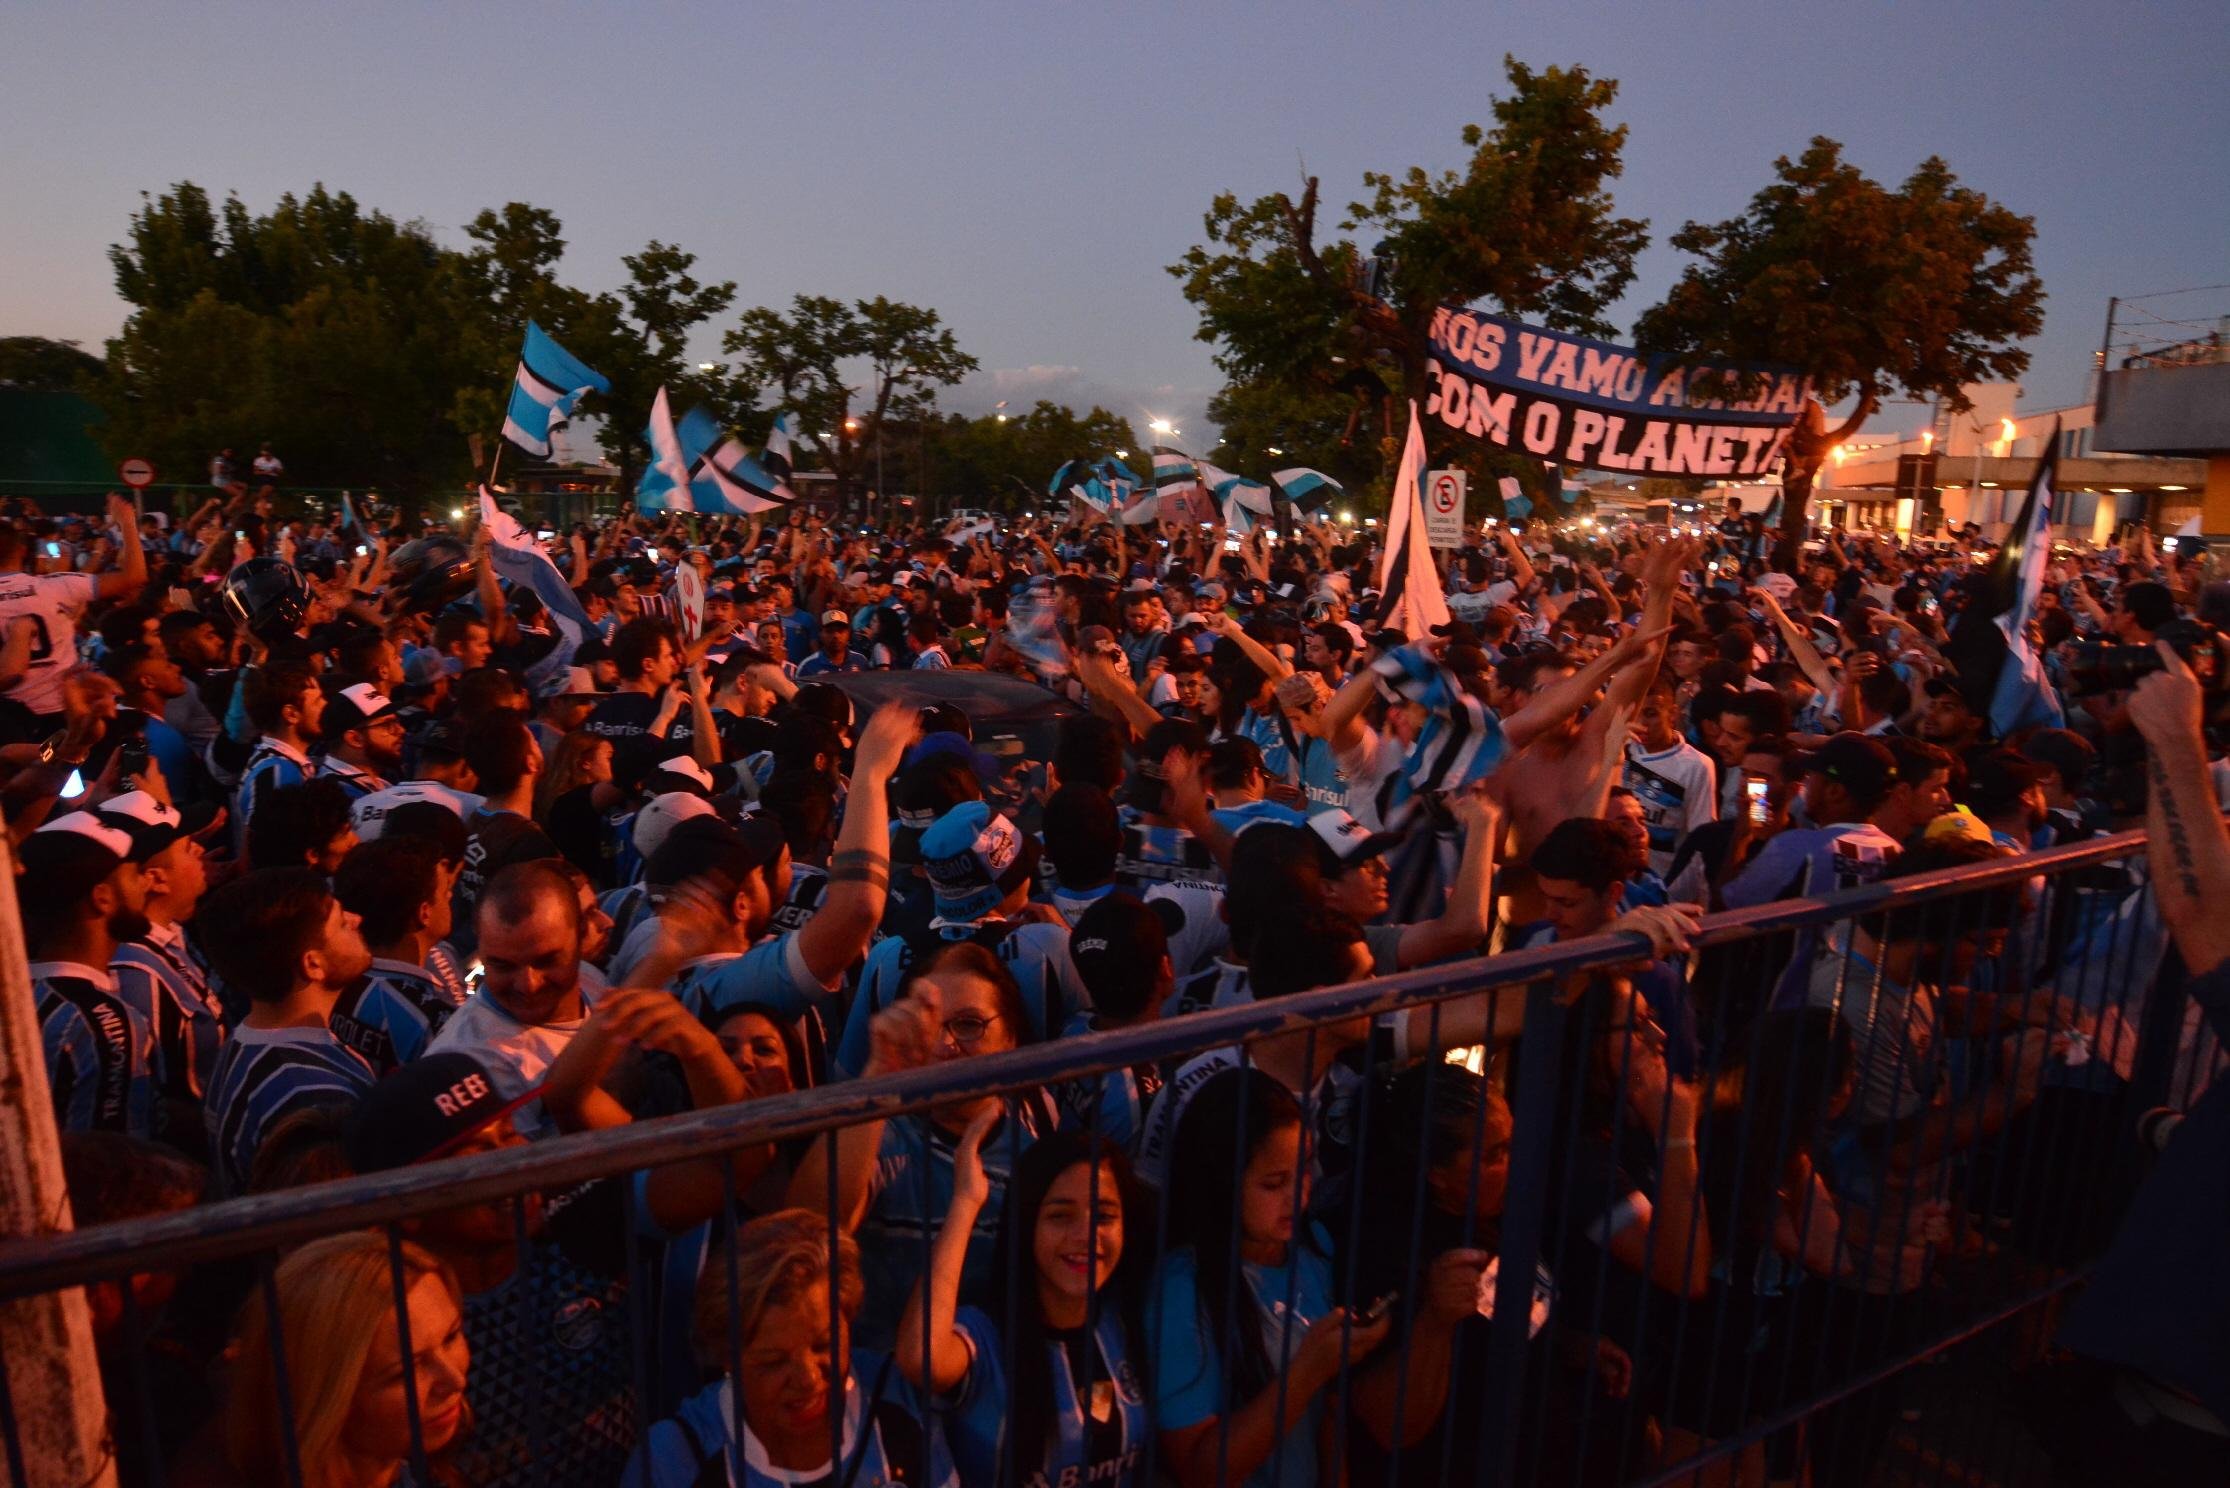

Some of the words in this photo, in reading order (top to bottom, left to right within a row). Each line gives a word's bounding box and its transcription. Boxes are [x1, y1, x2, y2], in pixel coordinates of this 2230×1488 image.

[1426, 358, 1517, 446] COM
[1523, 401, 1561, 455] O
[1516, 333, 1647, 402] VAMO
[1146, 1057, 1228, 1159] TRANTINA
